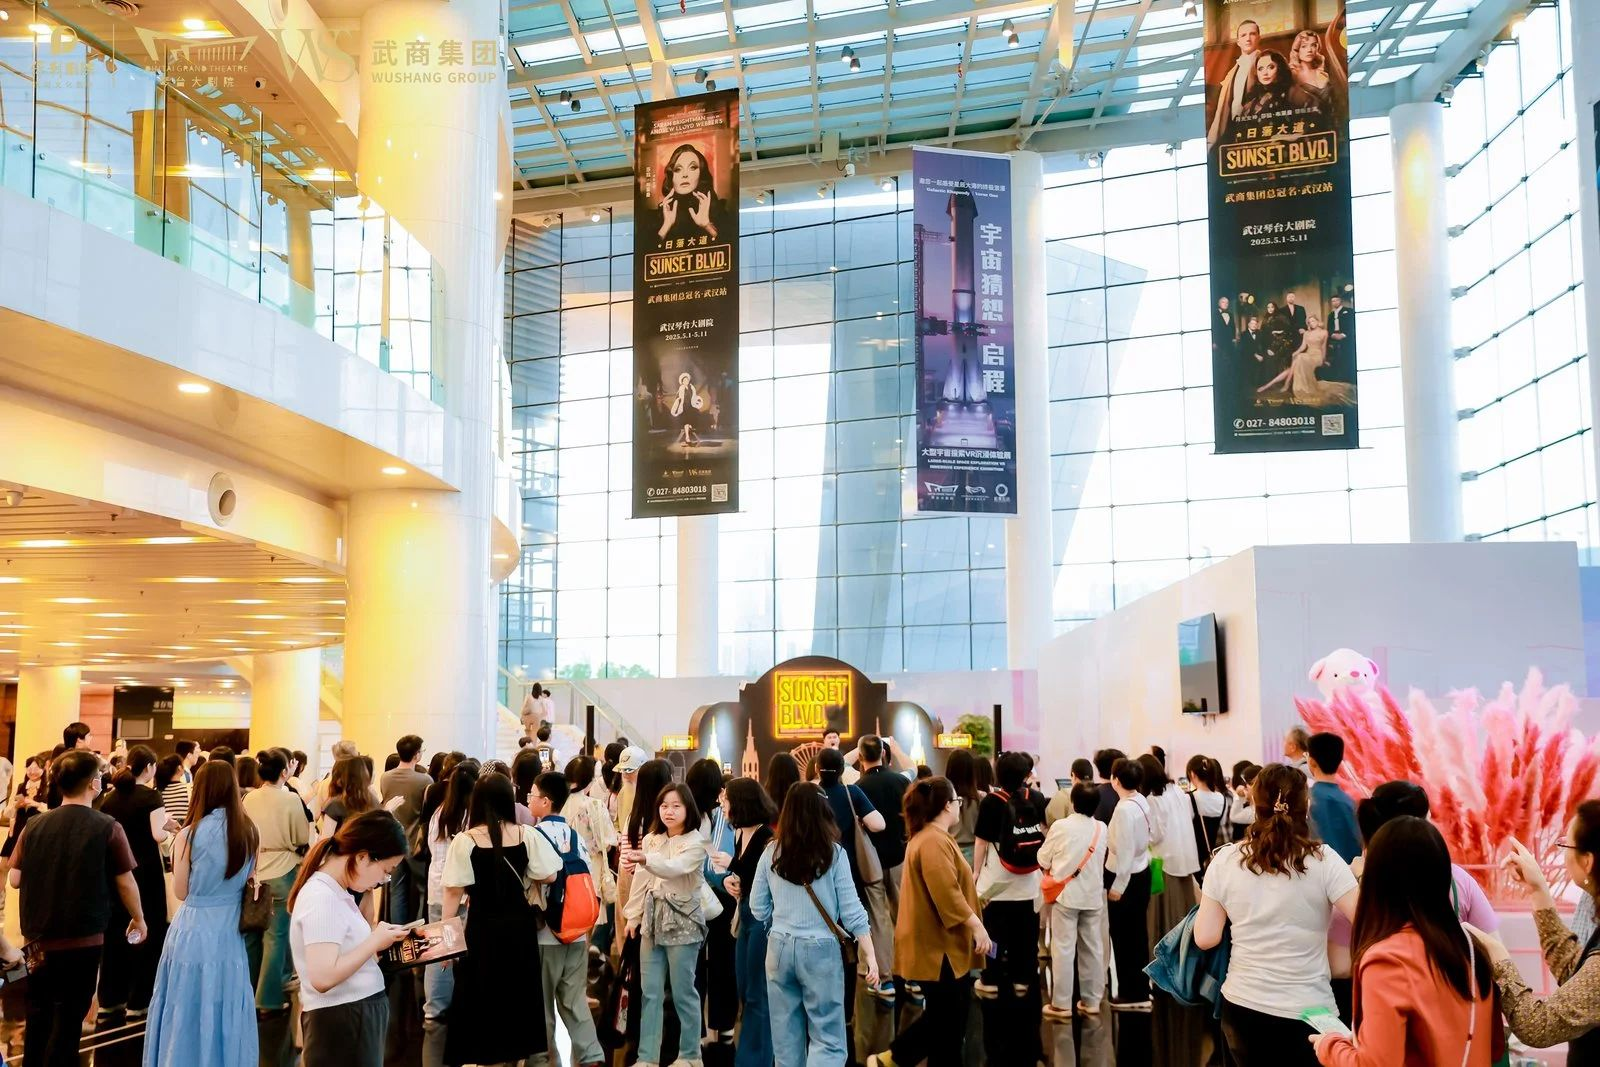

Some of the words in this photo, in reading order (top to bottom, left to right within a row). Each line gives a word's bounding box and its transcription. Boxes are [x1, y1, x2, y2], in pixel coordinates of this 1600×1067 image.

[1247, 121, 1305, 139] 日落大道
[1226, 144, 1285, 170] SUNSET
[1289, 138, 1332, 163] BLVD.
[1225, 182, 1333, 203] 武商集团总冠名·武汉站
[1242, 219, 1317, 236] 武汉琴台大剧院
[665, 235, 708, 250] 日落大道
[1250, 234, 1309, 246] 2025.5.1-5.11
[650, 254, 694, 276] SUNSET
[695, 251, 728, 270] BLVD.
[660, 319, 714, 332] 武汉琴台大剧院
[665, 330, 708, 341] 2025.5.1-5.11
[1246, 418, 1267, 428] 027-
[1268, 416, 1316, 427] 84803018
[656, 487, 671, 496] 027-
[672, 485, 707, 495] 84803018
[781, 680, 847, 702] SUNSET
